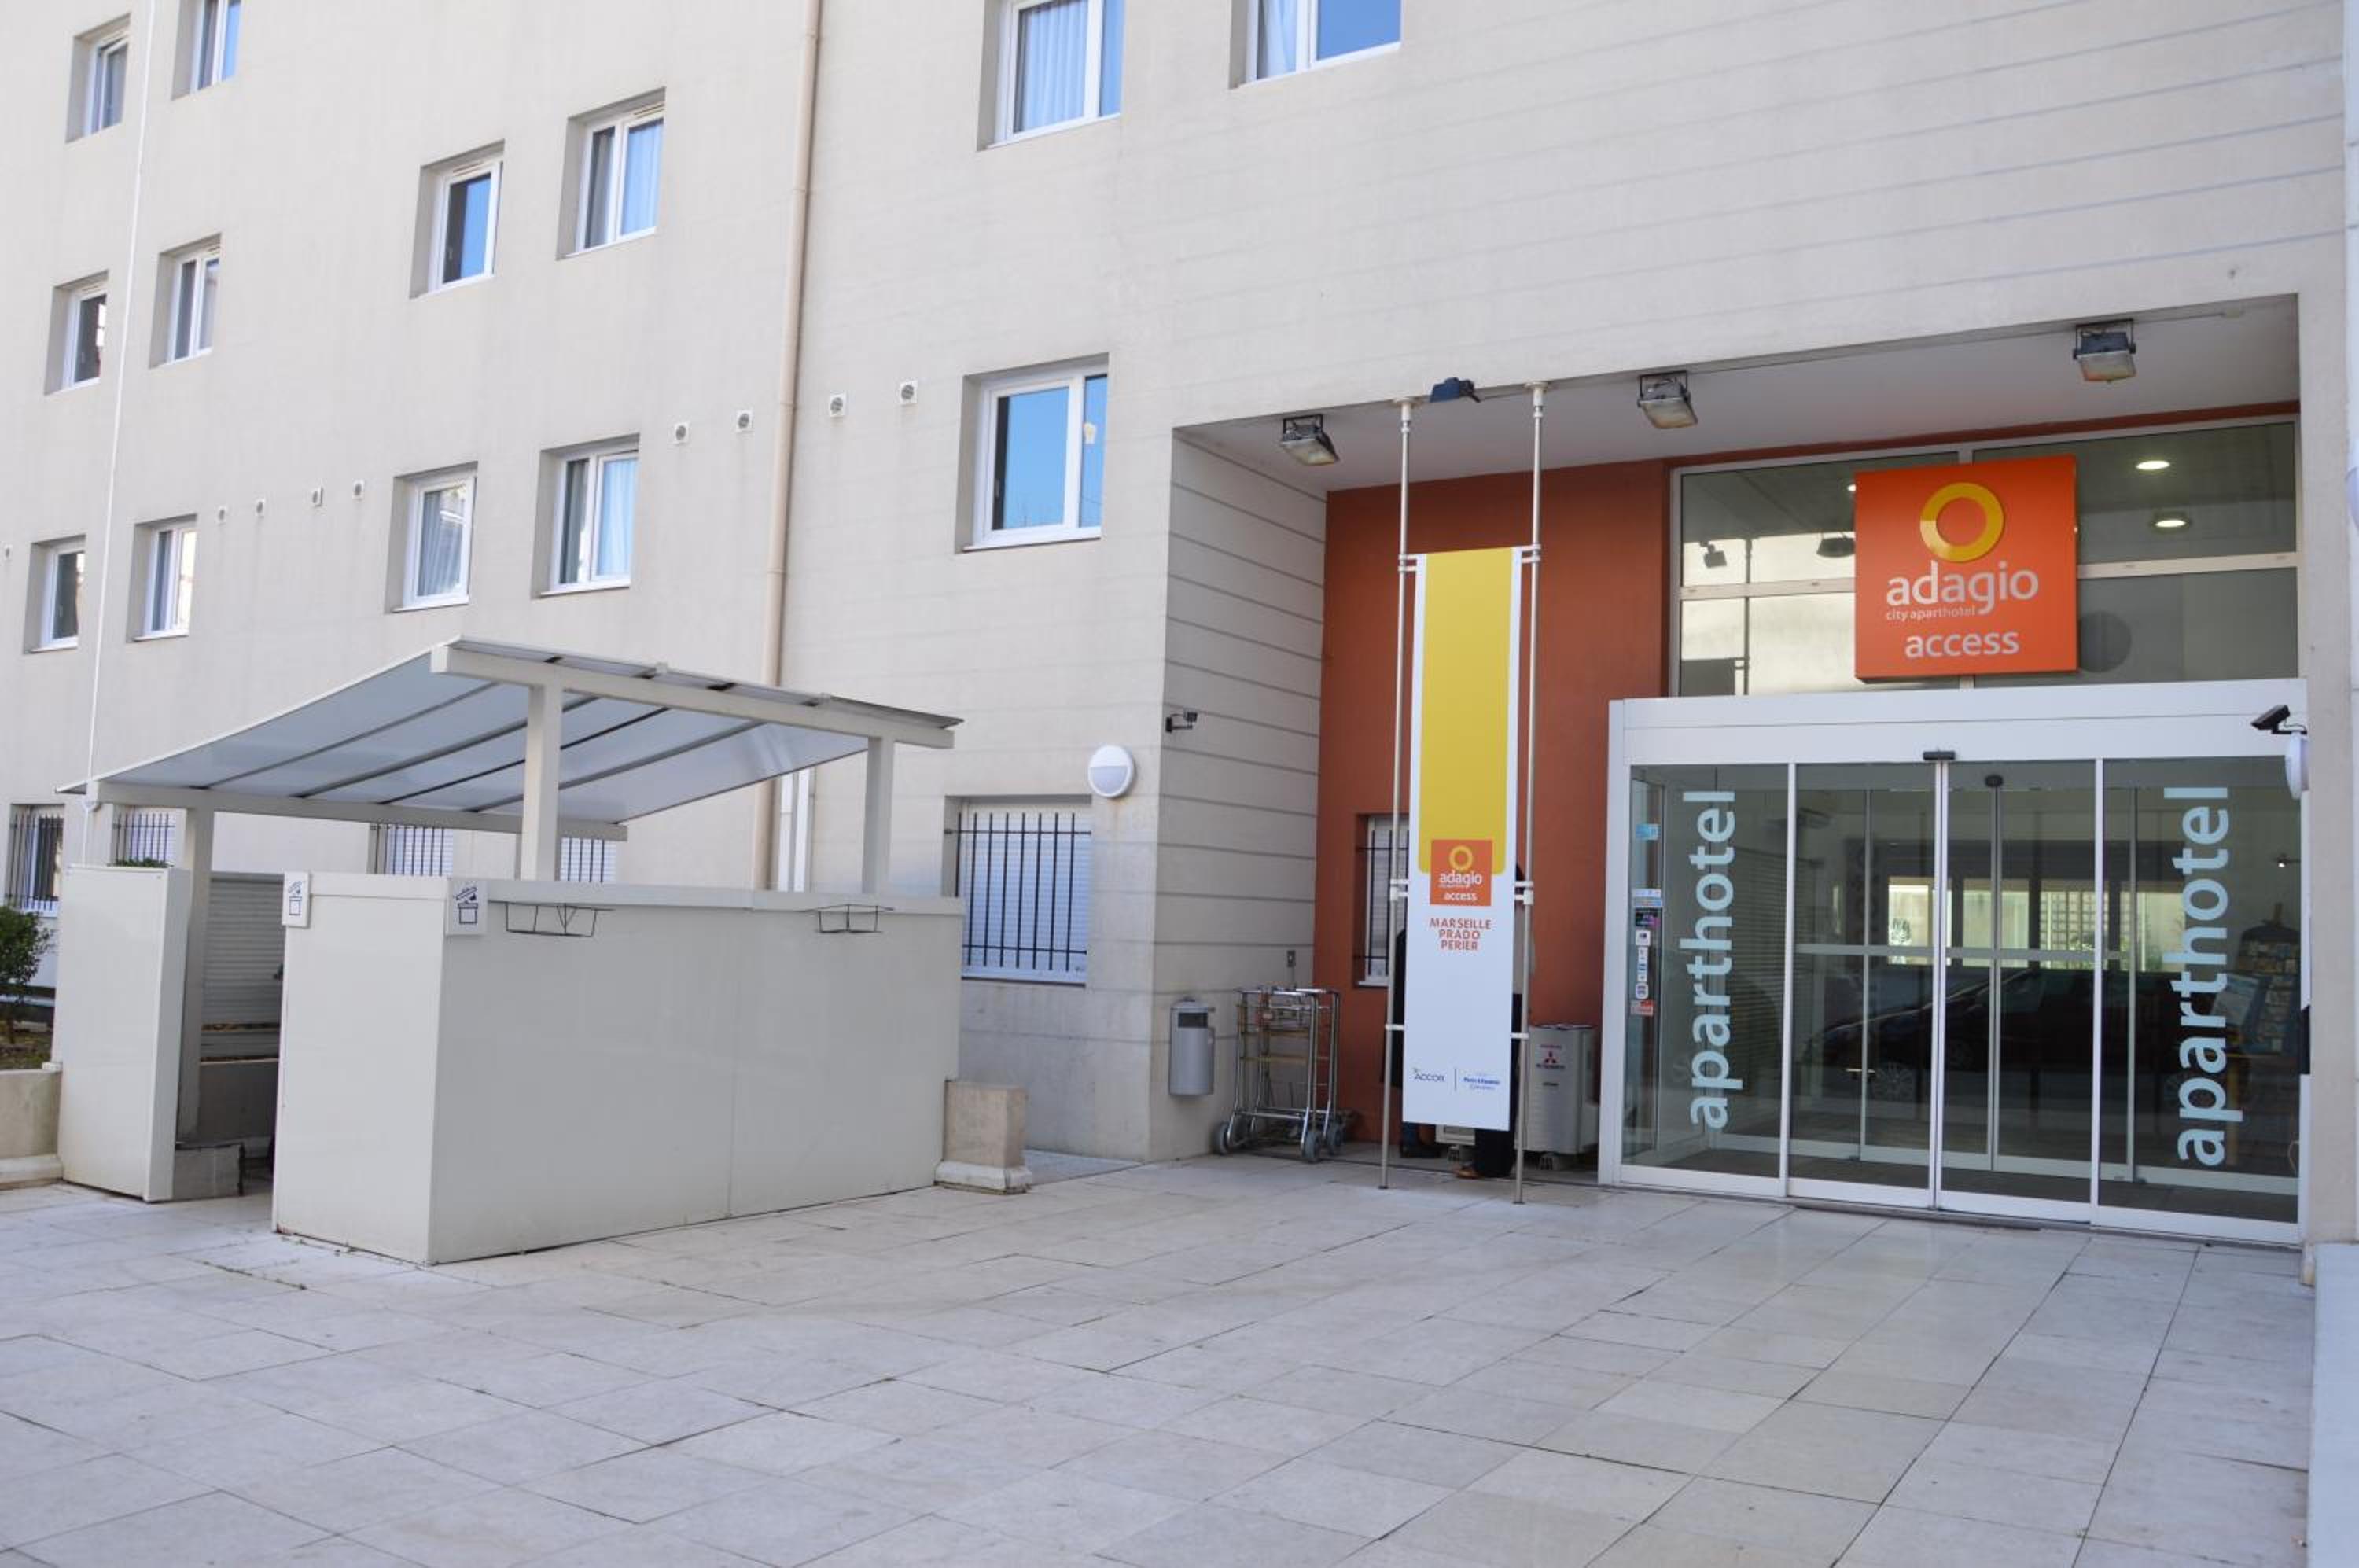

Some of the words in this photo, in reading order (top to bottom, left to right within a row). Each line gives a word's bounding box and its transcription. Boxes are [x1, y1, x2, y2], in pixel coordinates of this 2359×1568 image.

[1886, 559, 2039, 615] adagio
[1886, 609, 1908, 622] city
[1910, 605, 1975, 621] aparthotel
[1904, 631, 2019, 658] access
[1439, 870, 1483, 886] adagio
[1444, 892, 1478, 900] access
[1430, 918, 1492, 929] MARSEILLE
[1439, 929, 1481, 940] PRADO
[1441, 940, 1478, 950] PERIER
[1680, 791, 1743, 1130] aparthotel
[2163, 787, 2243, 1167] aparthotel
